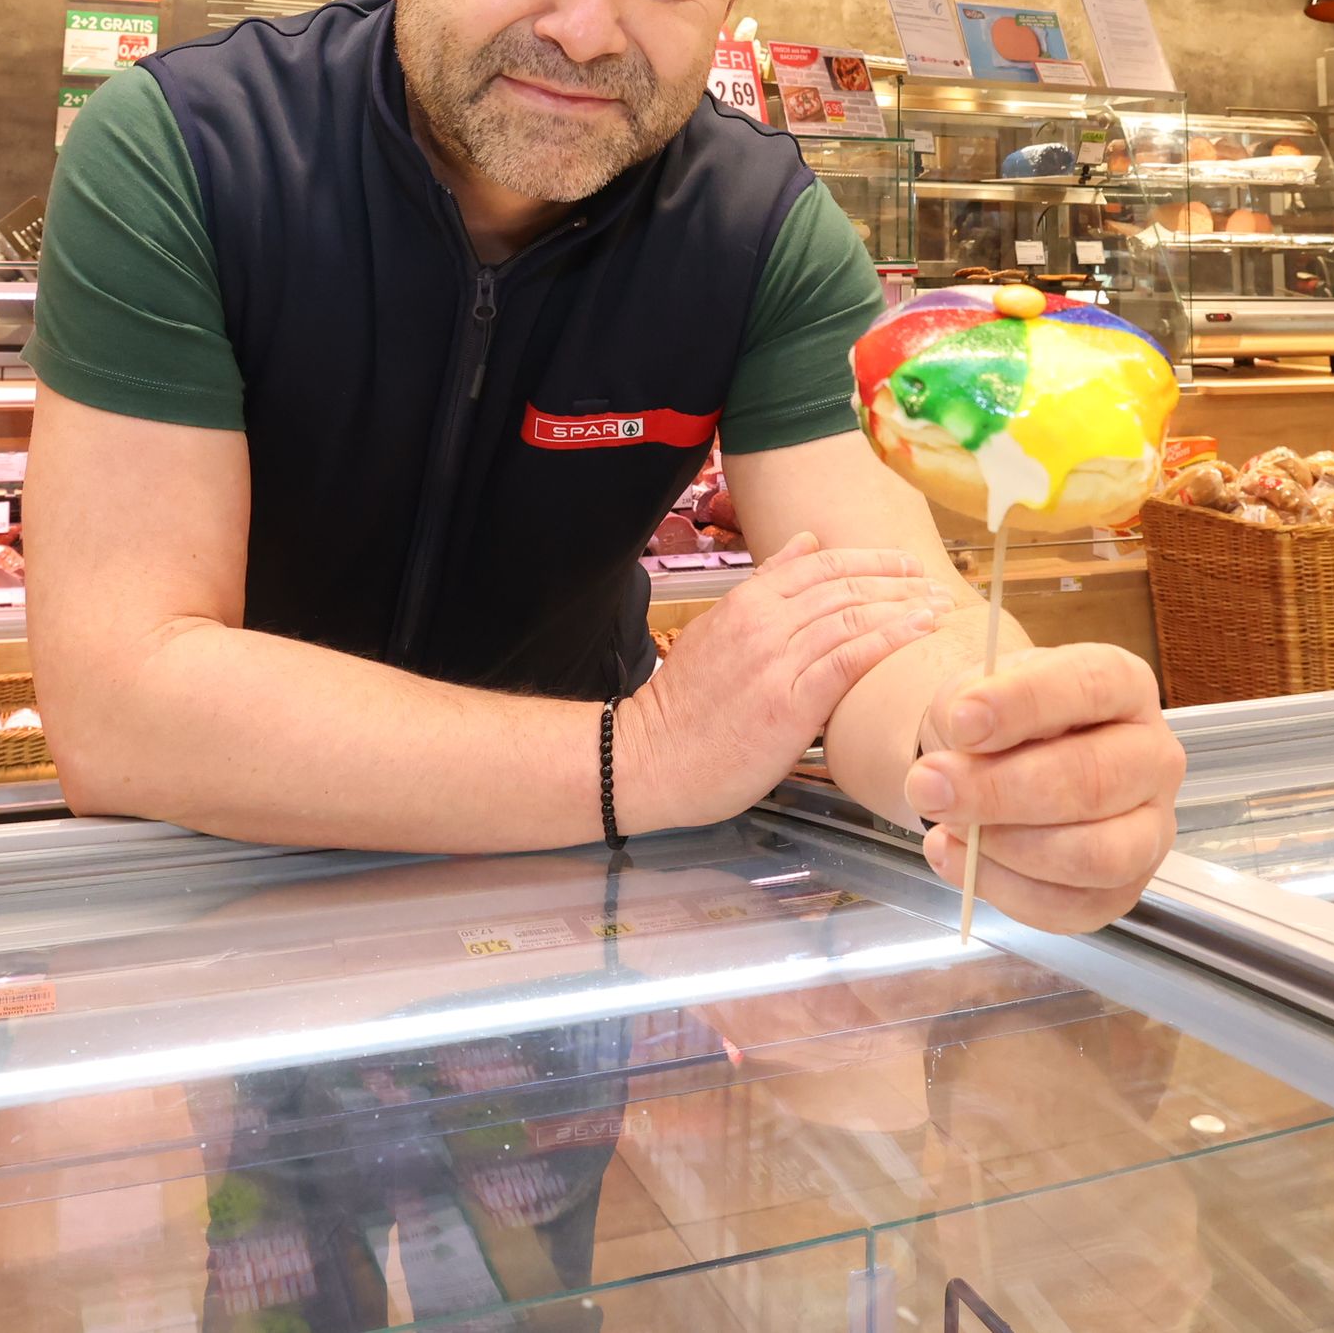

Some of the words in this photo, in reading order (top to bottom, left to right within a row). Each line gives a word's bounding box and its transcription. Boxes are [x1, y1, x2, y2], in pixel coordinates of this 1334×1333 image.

[70, 14, 98, 30] 2+2
[99, 16, 154, 33] GRATIS
[715, 49, 754, 70] ER!
[63, 92, 88, 107] 2+1
[715, 80, 756, 109] 2,69
[553, 421, 617, 438] SPAR
[469, 938, 512, 956] 5,19
